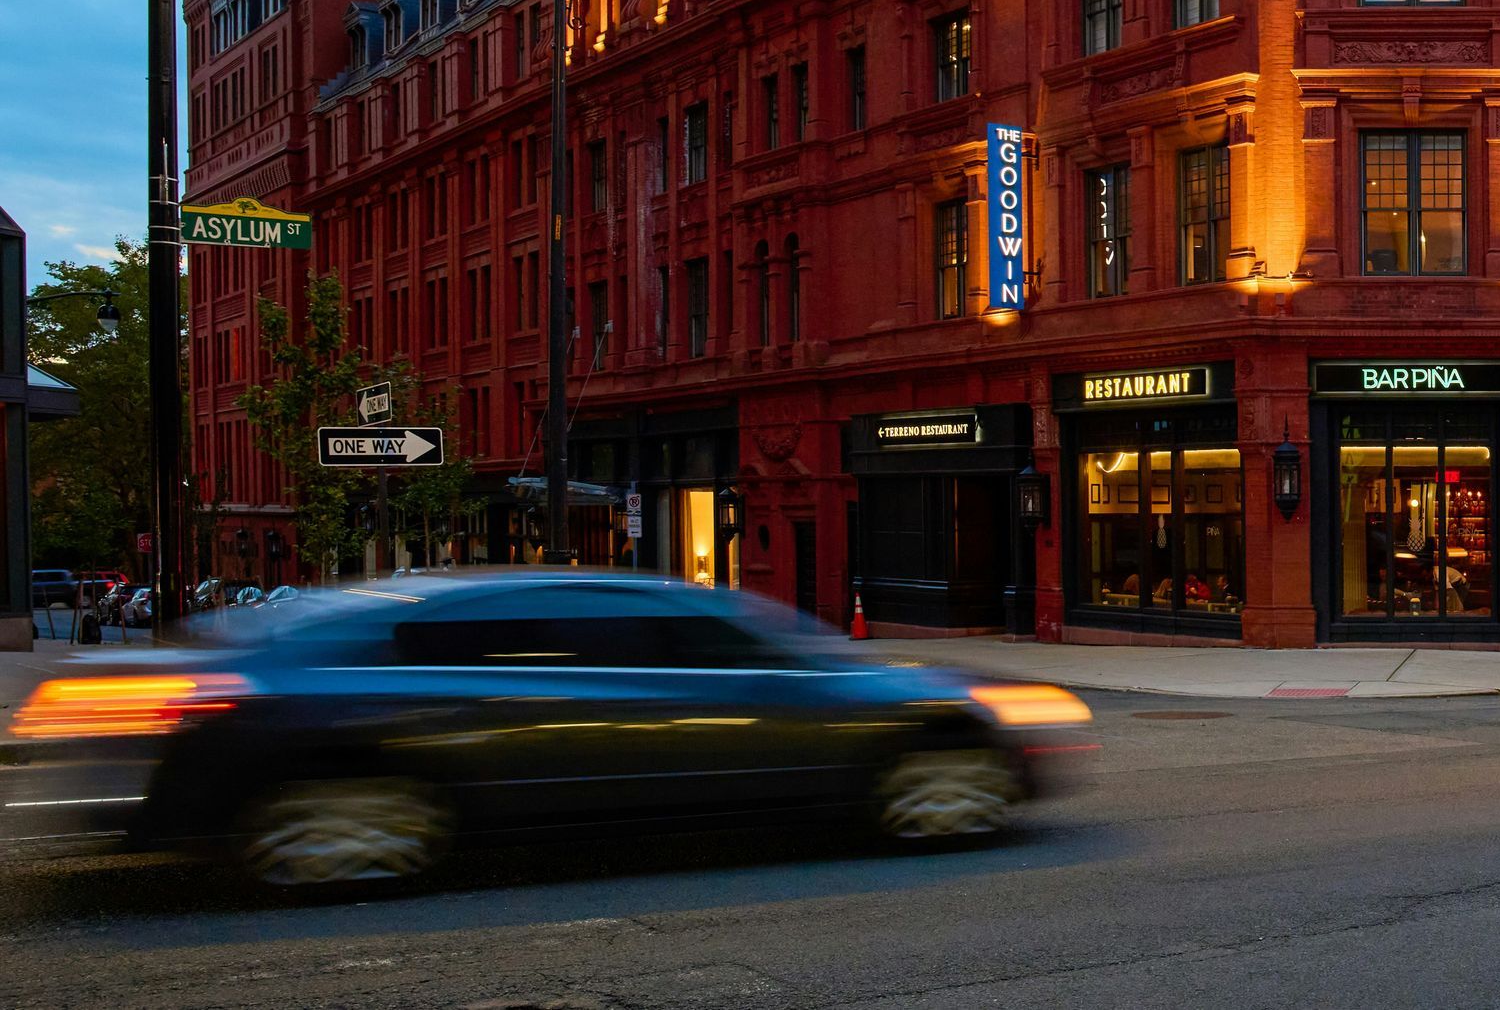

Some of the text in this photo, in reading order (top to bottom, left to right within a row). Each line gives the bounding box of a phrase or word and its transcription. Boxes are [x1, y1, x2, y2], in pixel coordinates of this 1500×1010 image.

[996, 128, 1021, 142] THE
[192, 216, 301, 244] ASYLUM ST
[998, 143, 1022, 304] GOODWIN
[1085, 372, 1190, 399] RESTAURANT
[1362, 366, 1465, 389] BAR PIÑA
[366, 394, 387, 413] ONE WAY
[885, 423, 968, 438] TERRENO RESTAURANT
[333, 440, 405, 453] ONE WAY
